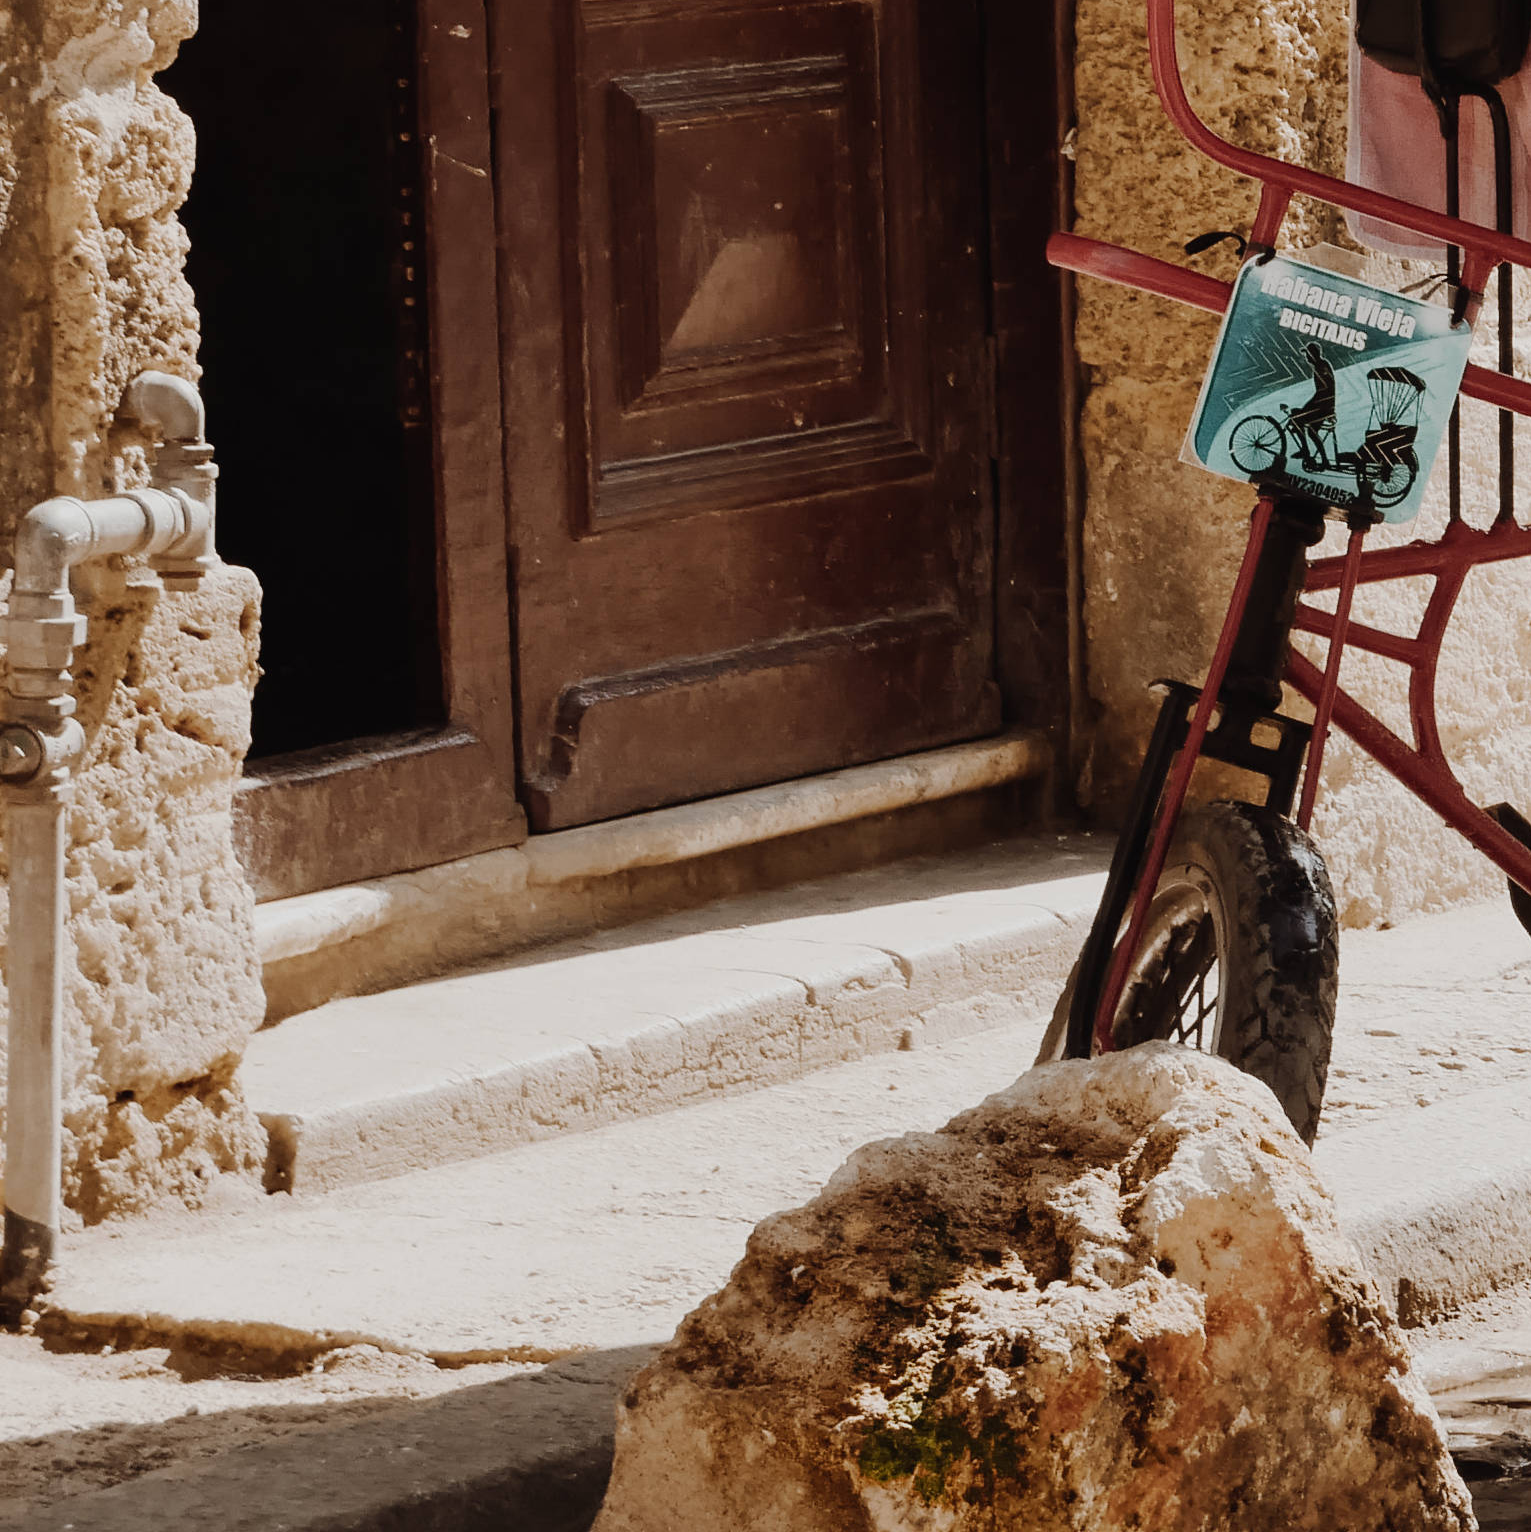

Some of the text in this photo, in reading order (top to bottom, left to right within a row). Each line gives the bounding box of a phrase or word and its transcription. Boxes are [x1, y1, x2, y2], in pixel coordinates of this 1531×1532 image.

[1260, 272, 1416, 339] Habana Vieja
[1279, 306, 1368, 351] BICITAXIS
